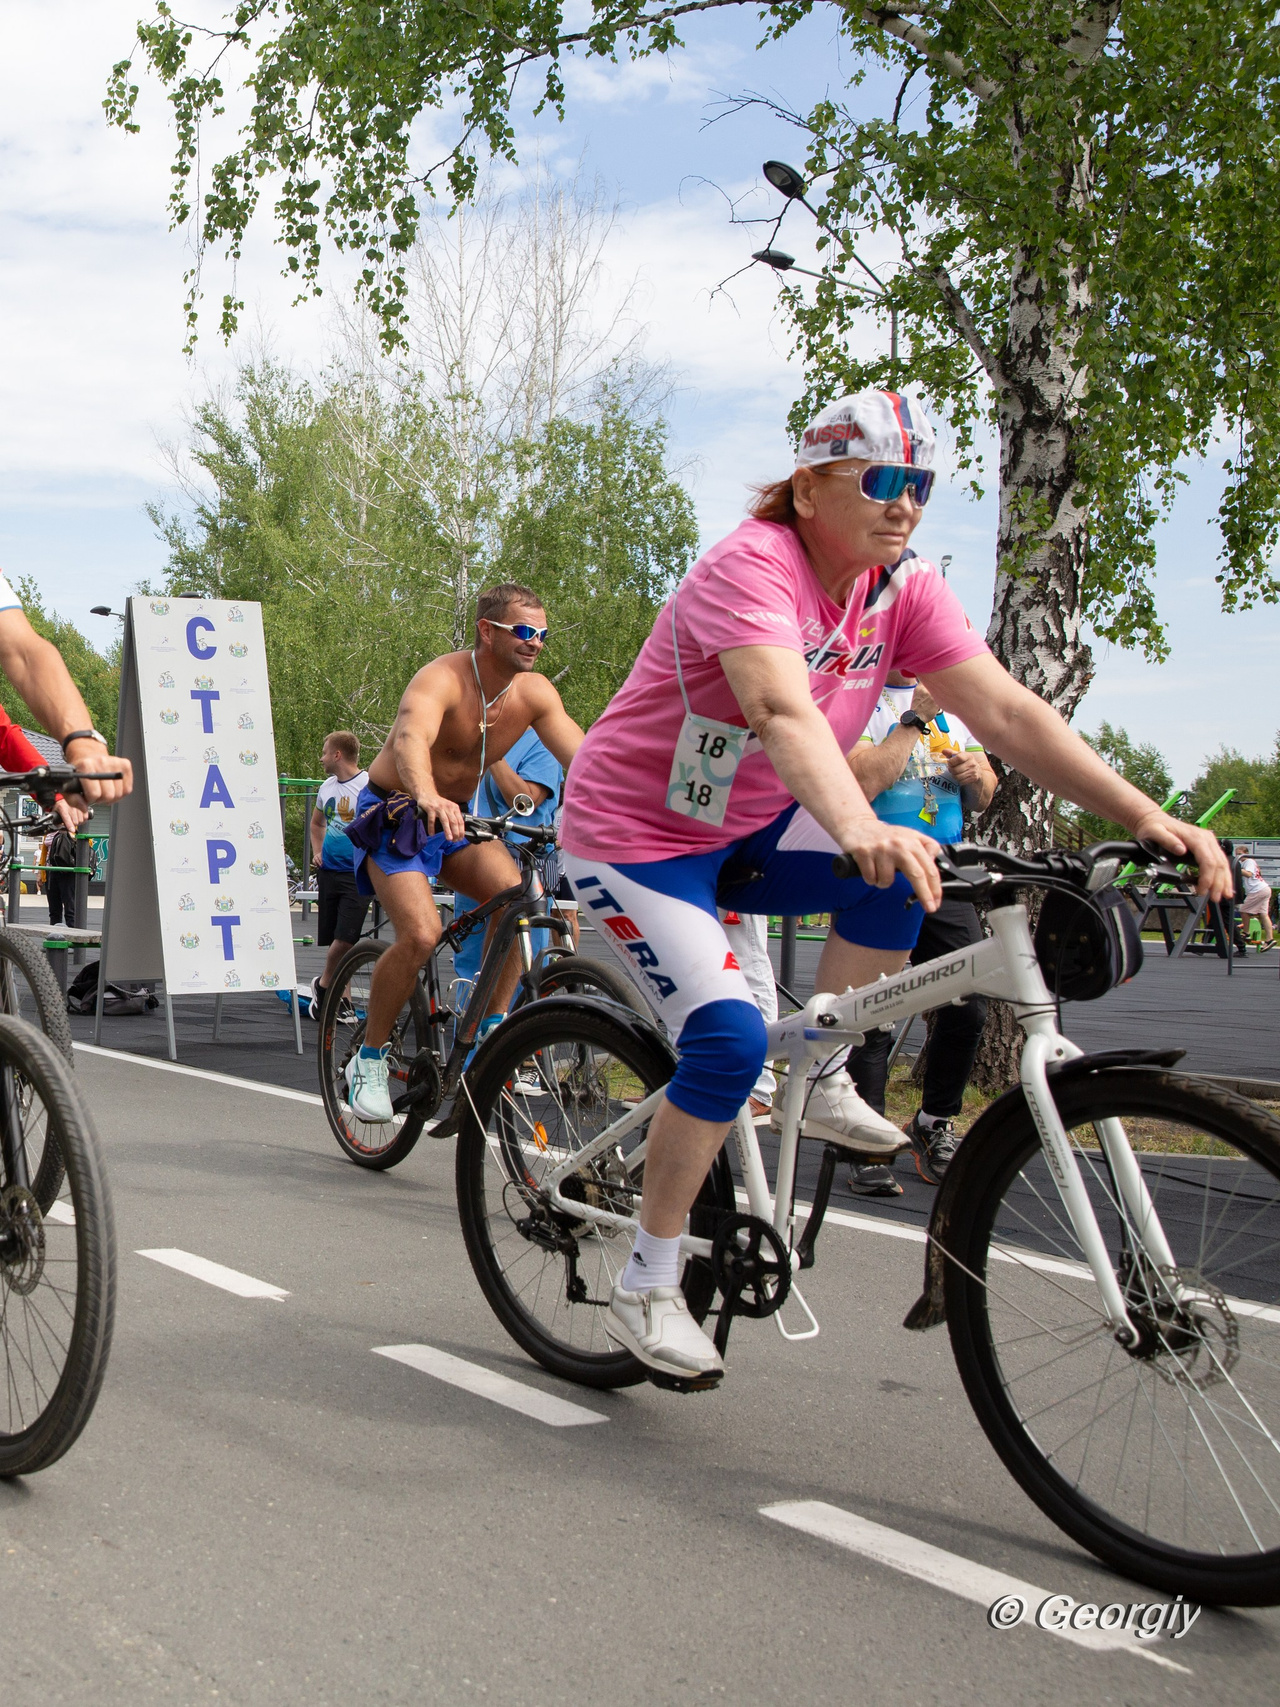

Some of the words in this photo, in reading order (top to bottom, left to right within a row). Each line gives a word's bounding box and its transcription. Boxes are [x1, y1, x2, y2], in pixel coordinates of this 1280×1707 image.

[695, 732, 727, 759] 18
[186, 616, 241, 961] СТАРТ
[684, 780, 712, 806] 18
[574, 876, 678, 998] ITERA
[862, 958, 966, 1010] FORWARD
[1026, 1090, 1065, 1180] FORWARD
